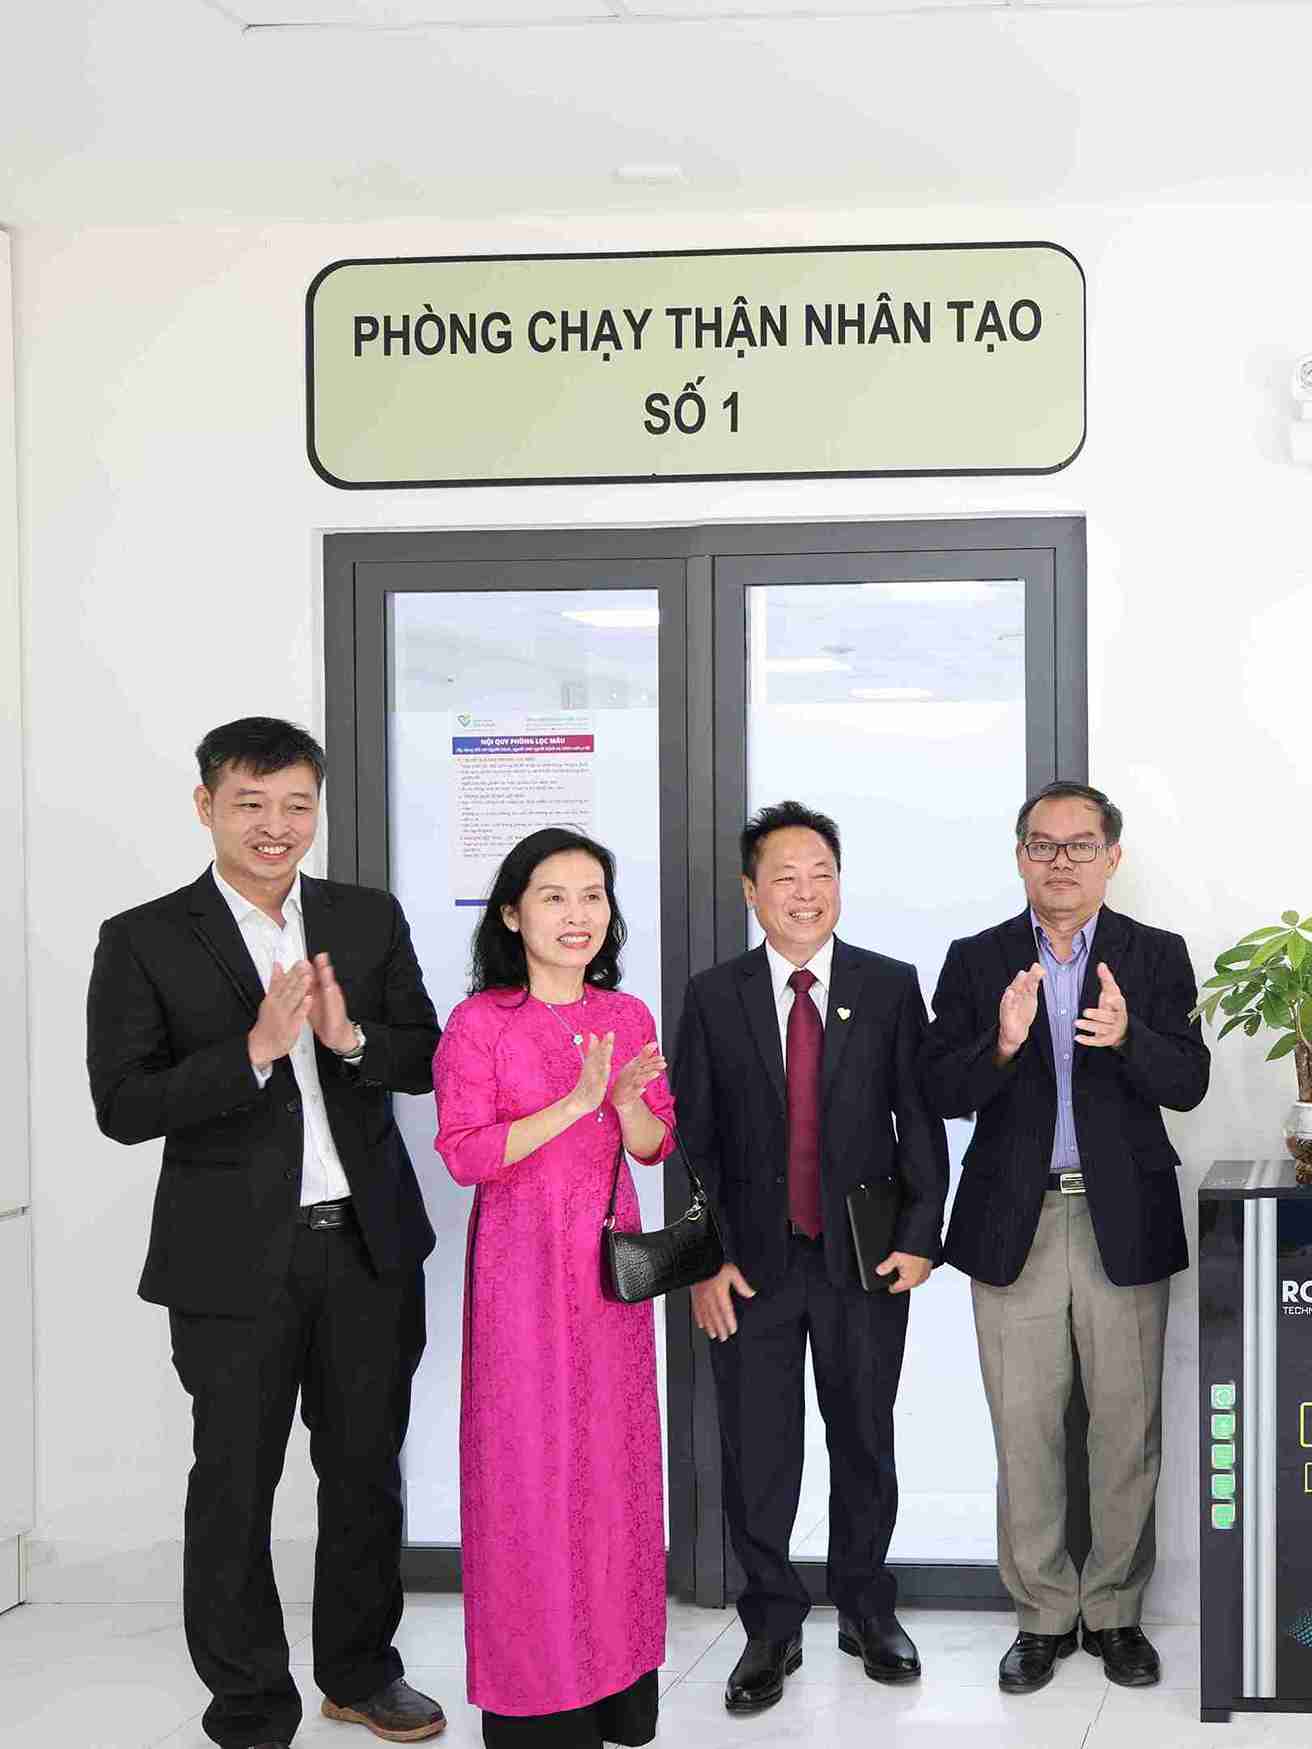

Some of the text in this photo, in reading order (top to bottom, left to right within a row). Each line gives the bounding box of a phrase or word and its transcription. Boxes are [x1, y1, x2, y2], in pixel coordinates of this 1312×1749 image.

[354, 291, 1043, 362] PHÒNG CHẠY THẬN NHÂN TẠO
[643, 375, 739, 436] SỐ 1
